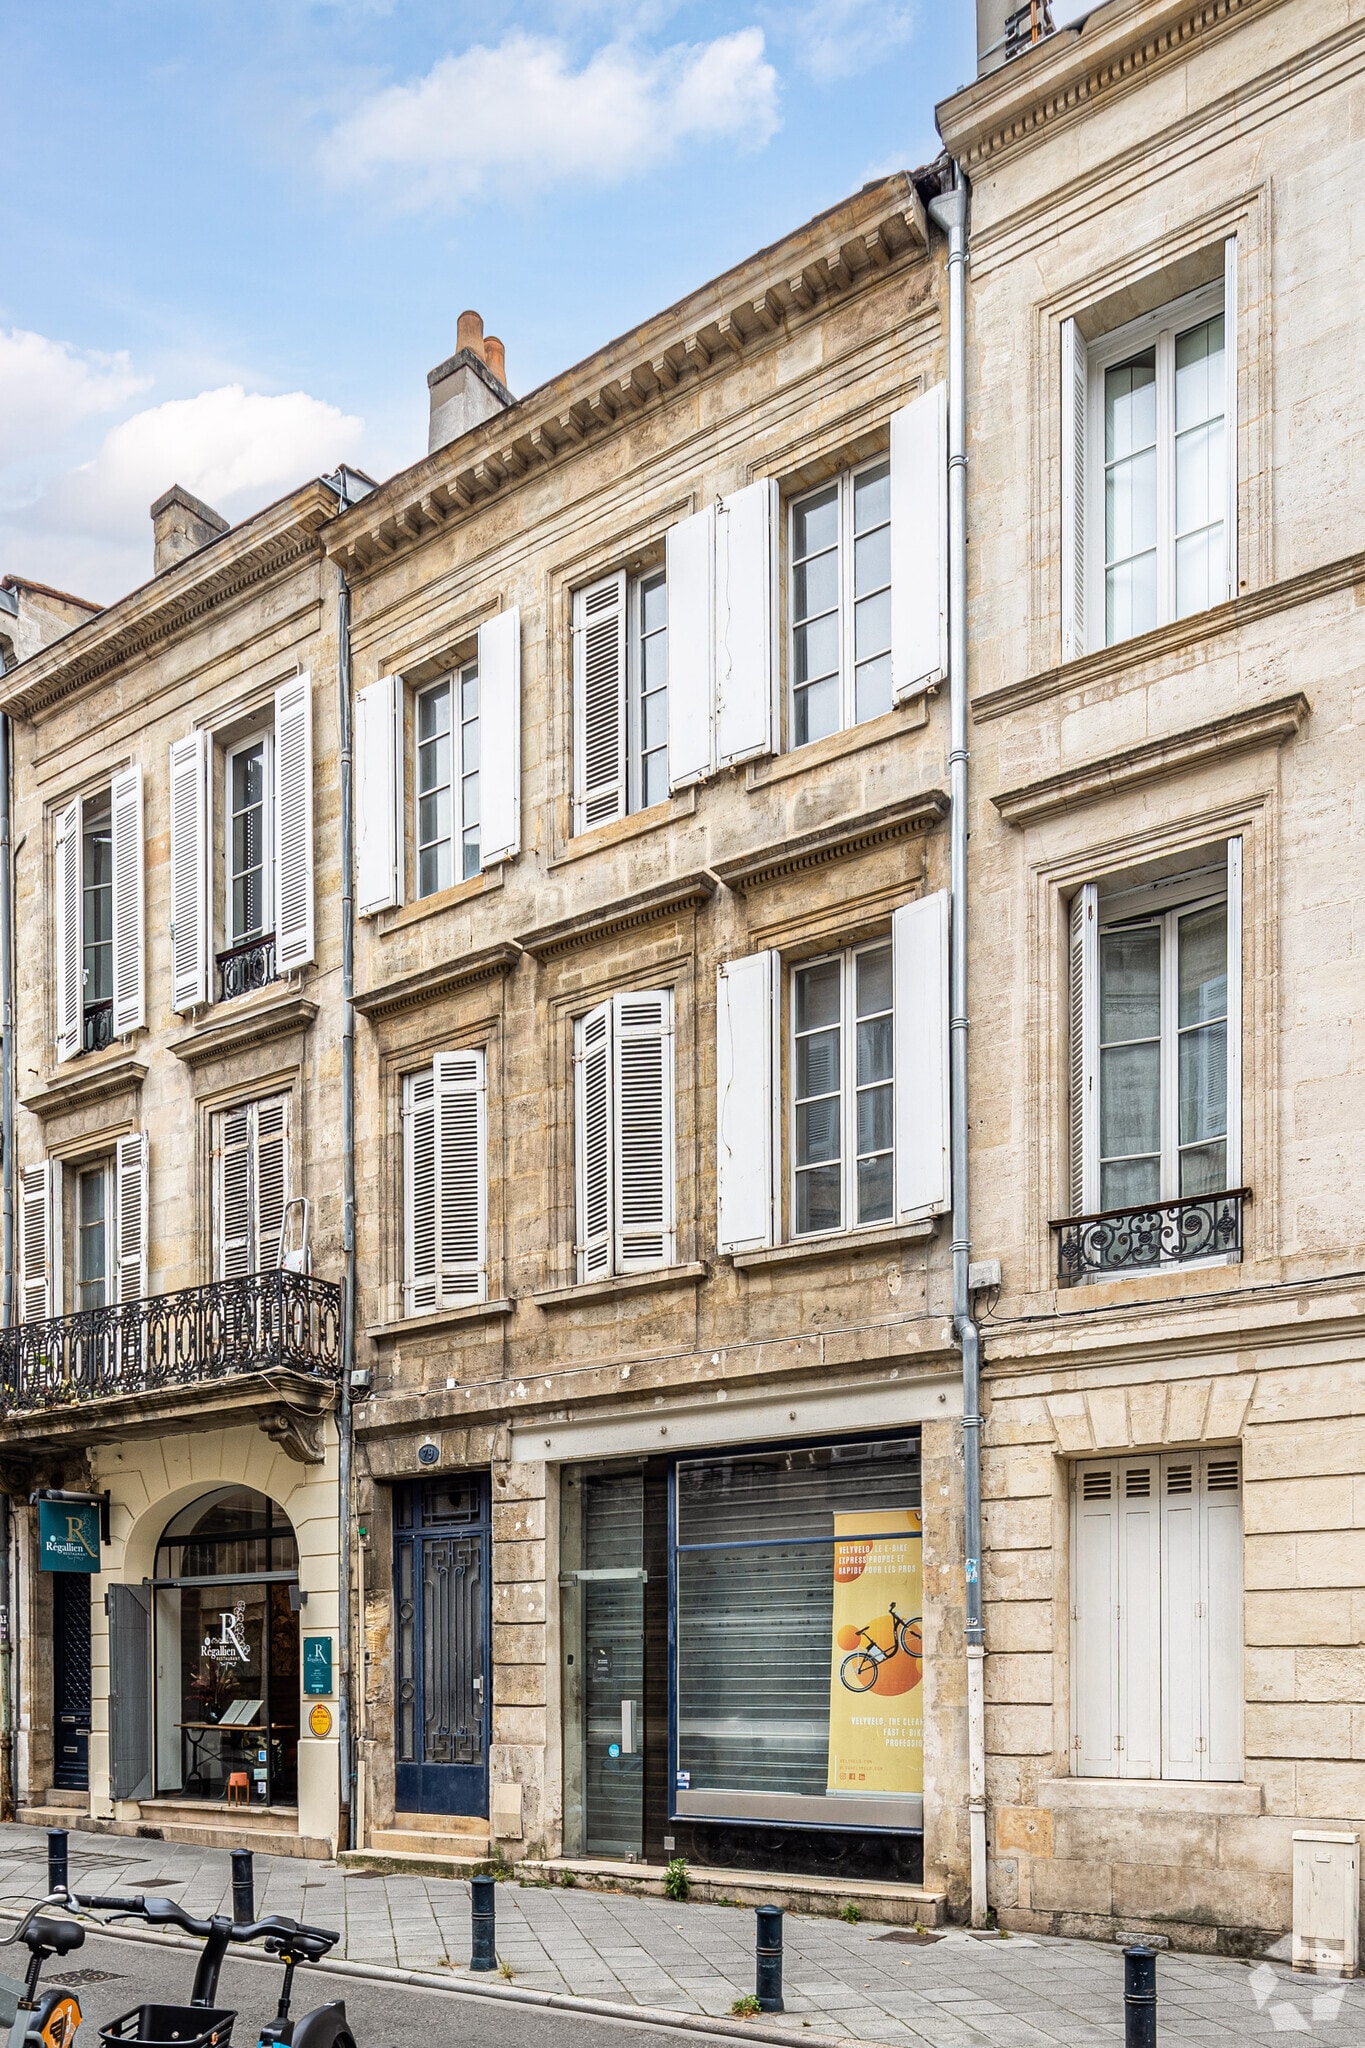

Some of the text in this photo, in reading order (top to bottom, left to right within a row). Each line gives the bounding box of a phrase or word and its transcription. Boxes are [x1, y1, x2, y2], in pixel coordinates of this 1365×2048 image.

[65, 1516, 98, 1558] R
[46, 1541, 84, 1554] Régallien
[874, 1545, 882, 1553] LE
[884, 1544, 908, 1553] E-BIKE
[838, 1555, 905, 1565] EXPRESS PROPRE ET
[838, 1564, 916, 1575] RAPIDE POUR LES PROS
[219, 1612, 251, 1662] R
[200, 1645, 236, 1659] Régallien
[888, 1717, 901, 1726] THE
[883, 1728, 899, 1737] FAST
